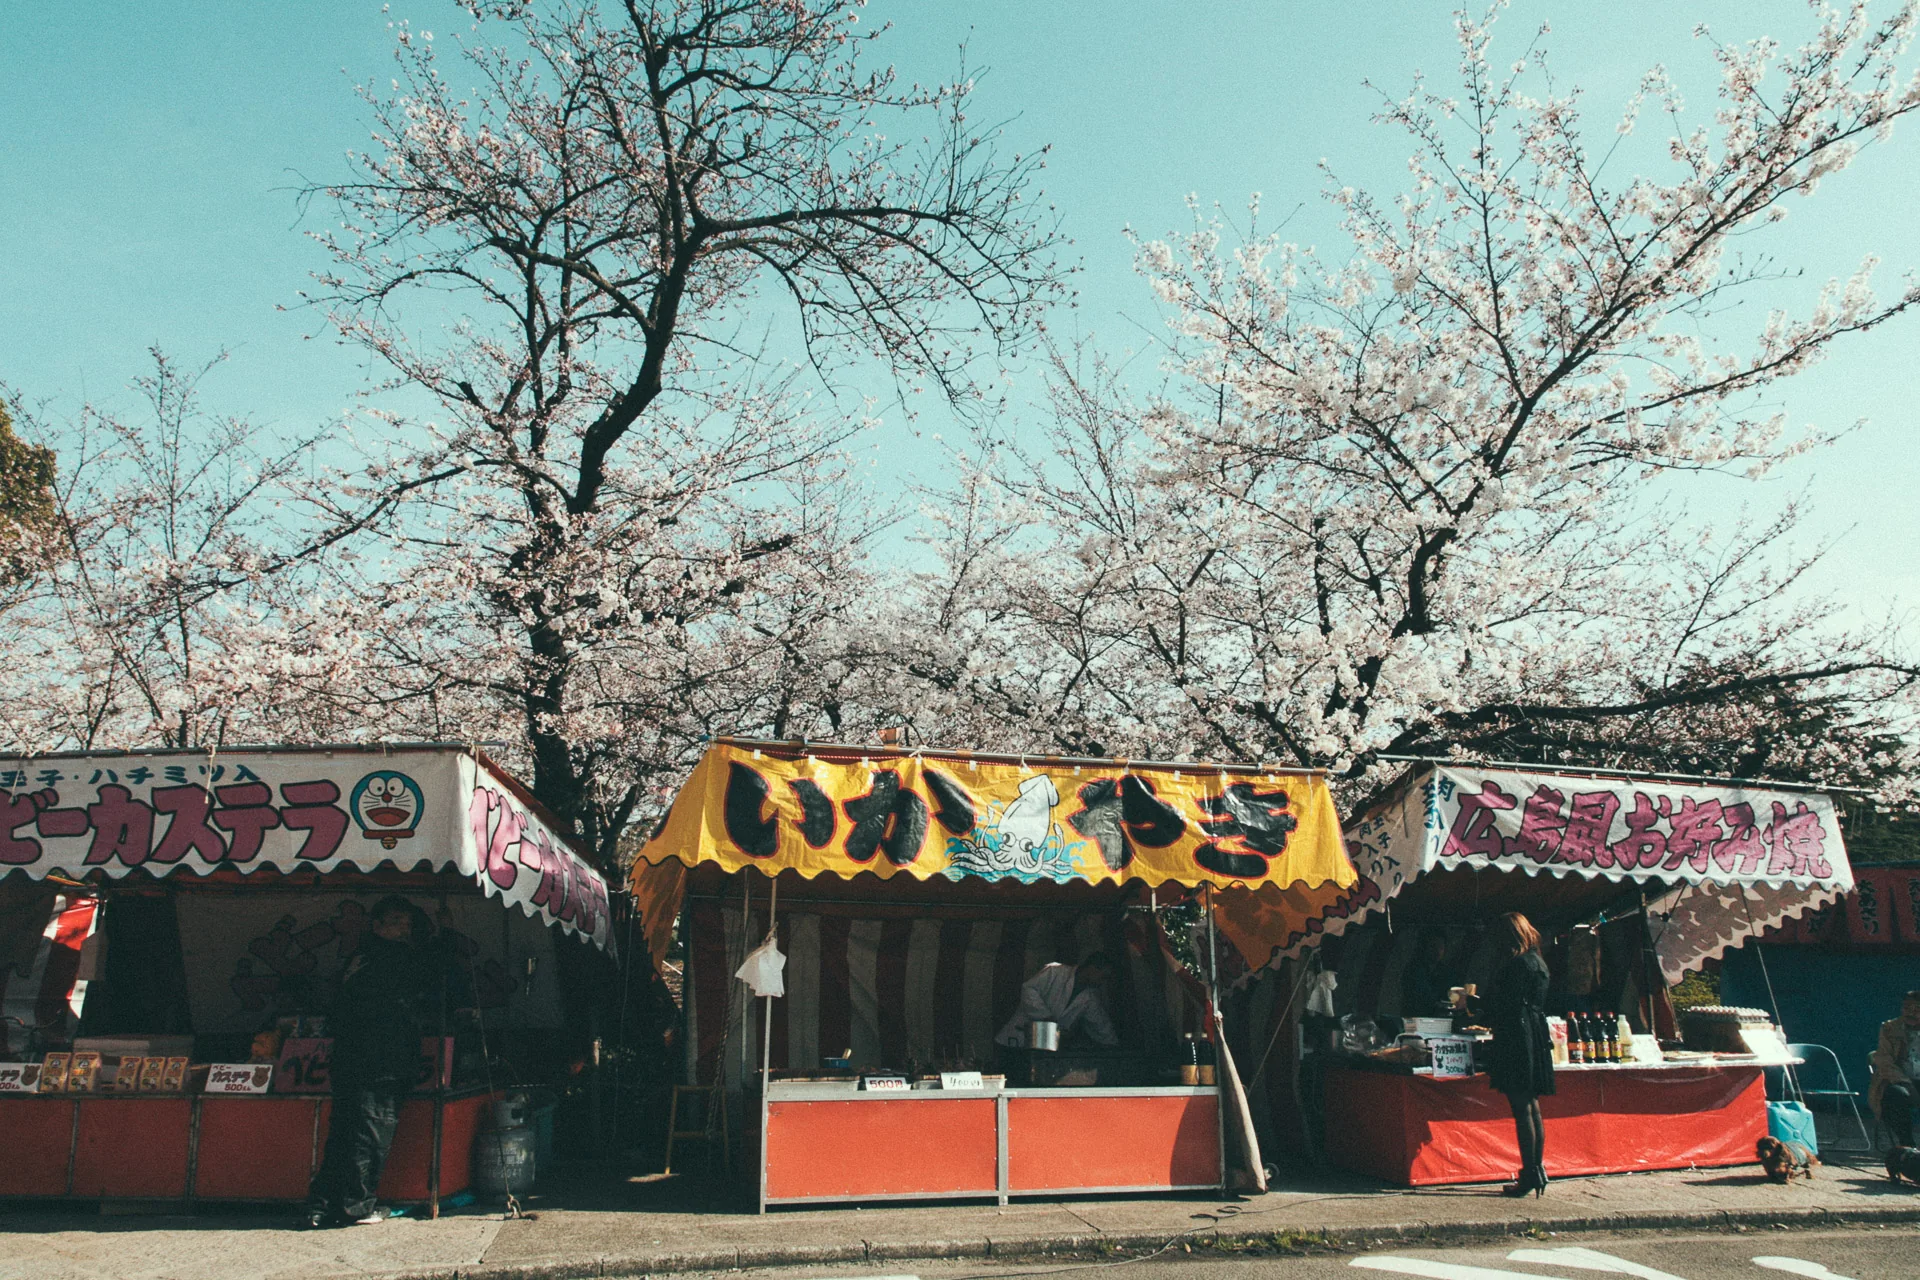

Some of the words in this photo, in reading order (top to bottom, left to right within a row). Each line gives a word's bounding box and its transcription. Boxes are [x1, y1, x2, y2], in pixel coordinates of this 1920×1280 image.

[1442, 780, 1833, 878] 広島風お好み焼
[211, 1071, 251, 1083] カステラ
[869, 1079, 903, 1089] 500円
